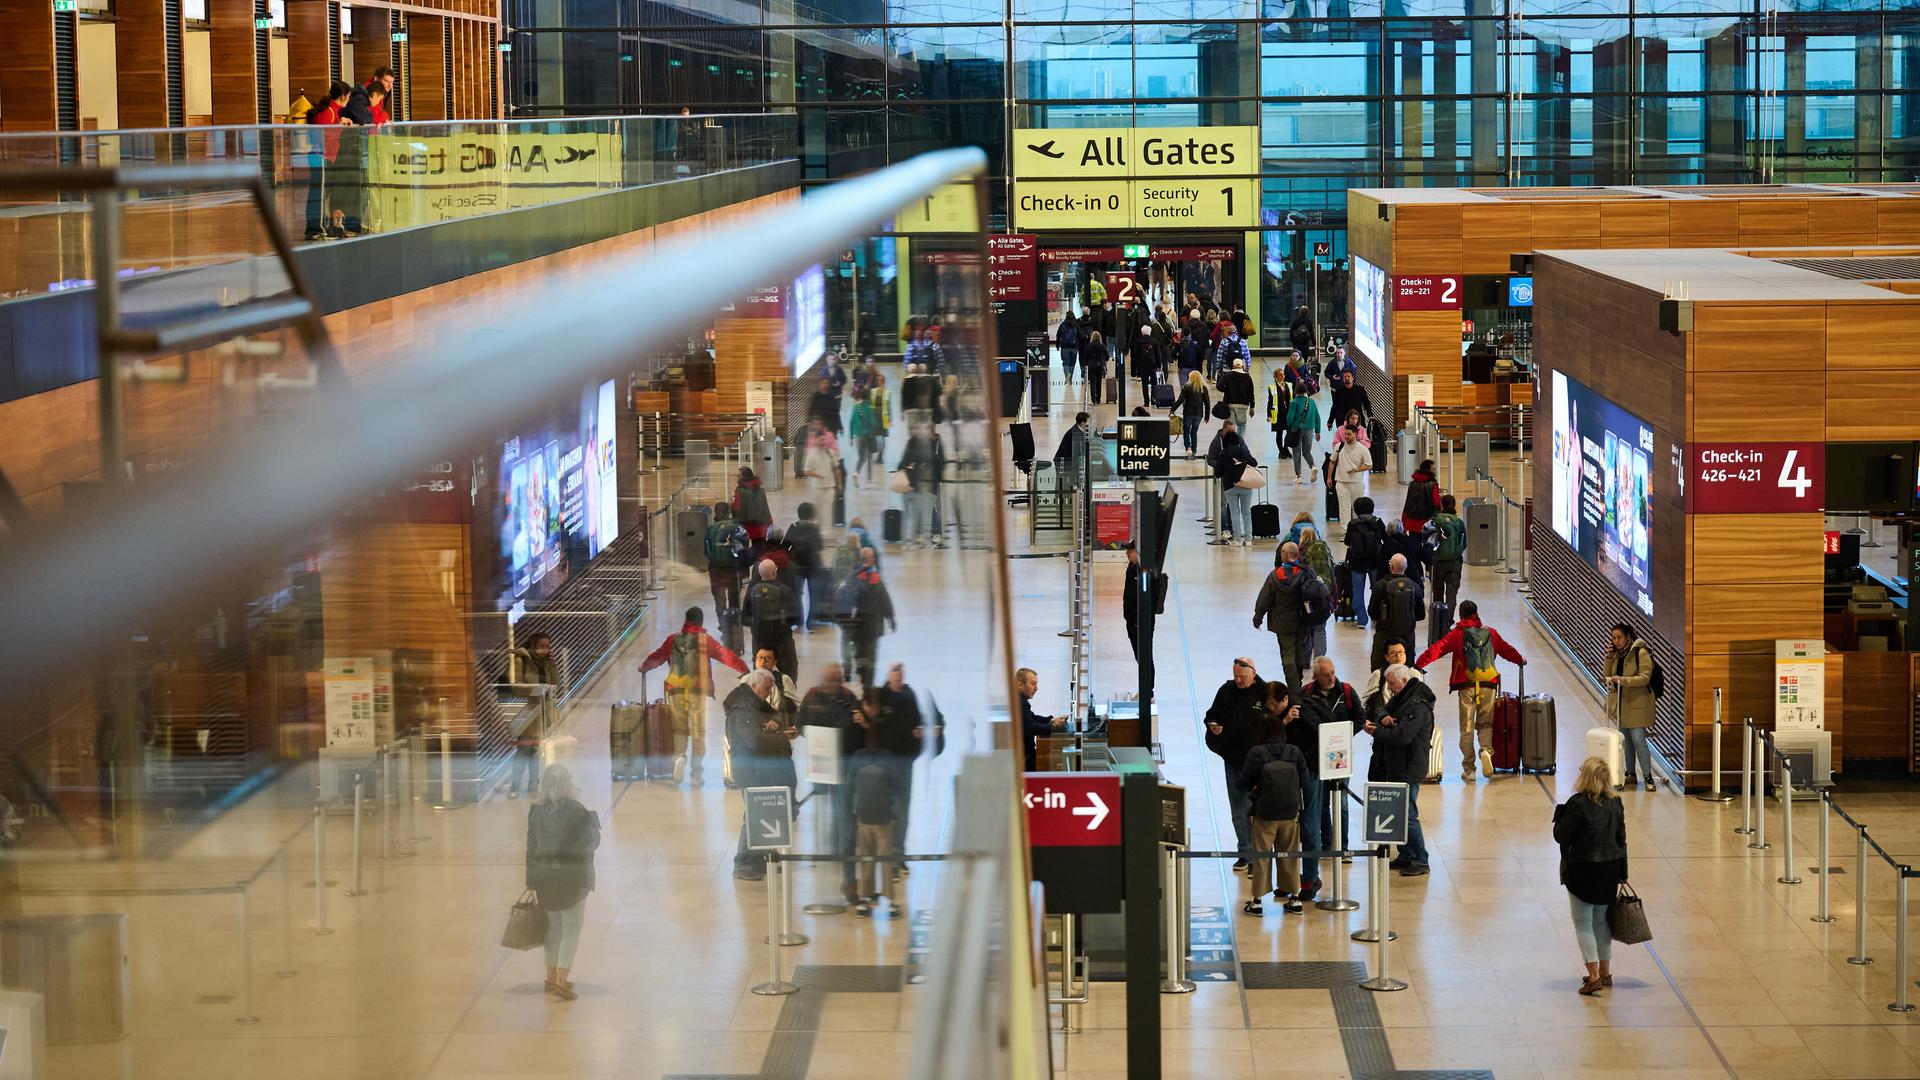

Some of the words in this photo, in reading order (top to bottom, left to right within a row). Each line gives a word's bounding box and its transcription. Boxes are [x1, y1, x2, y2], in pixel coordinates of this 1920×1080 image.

[1080, 137, 1126, 166] All
[1143, 137, 1235, 166] Gates
[1143, 186, 1199, 202] Security
[1220, 187, 1234, 216] 1
[1020, 194, 1101, 211] Check-in
[1108, 194, 1119, 211] 0
[1143, 205, 1194, 218] Control
[1118, 277, 1133, 301] 2
[1400, 278, 1432, 286] Check-in
[1441, 278, 1457, 303] 2
[1120, 444, 1168, 459] Priority
[1701, 449, 1763, 463] Check-in
[1120, 459, 1150, 470] Lane
[1777, 450, 1812, 498] 4
[1378, 789, 1400, 798] Priority
